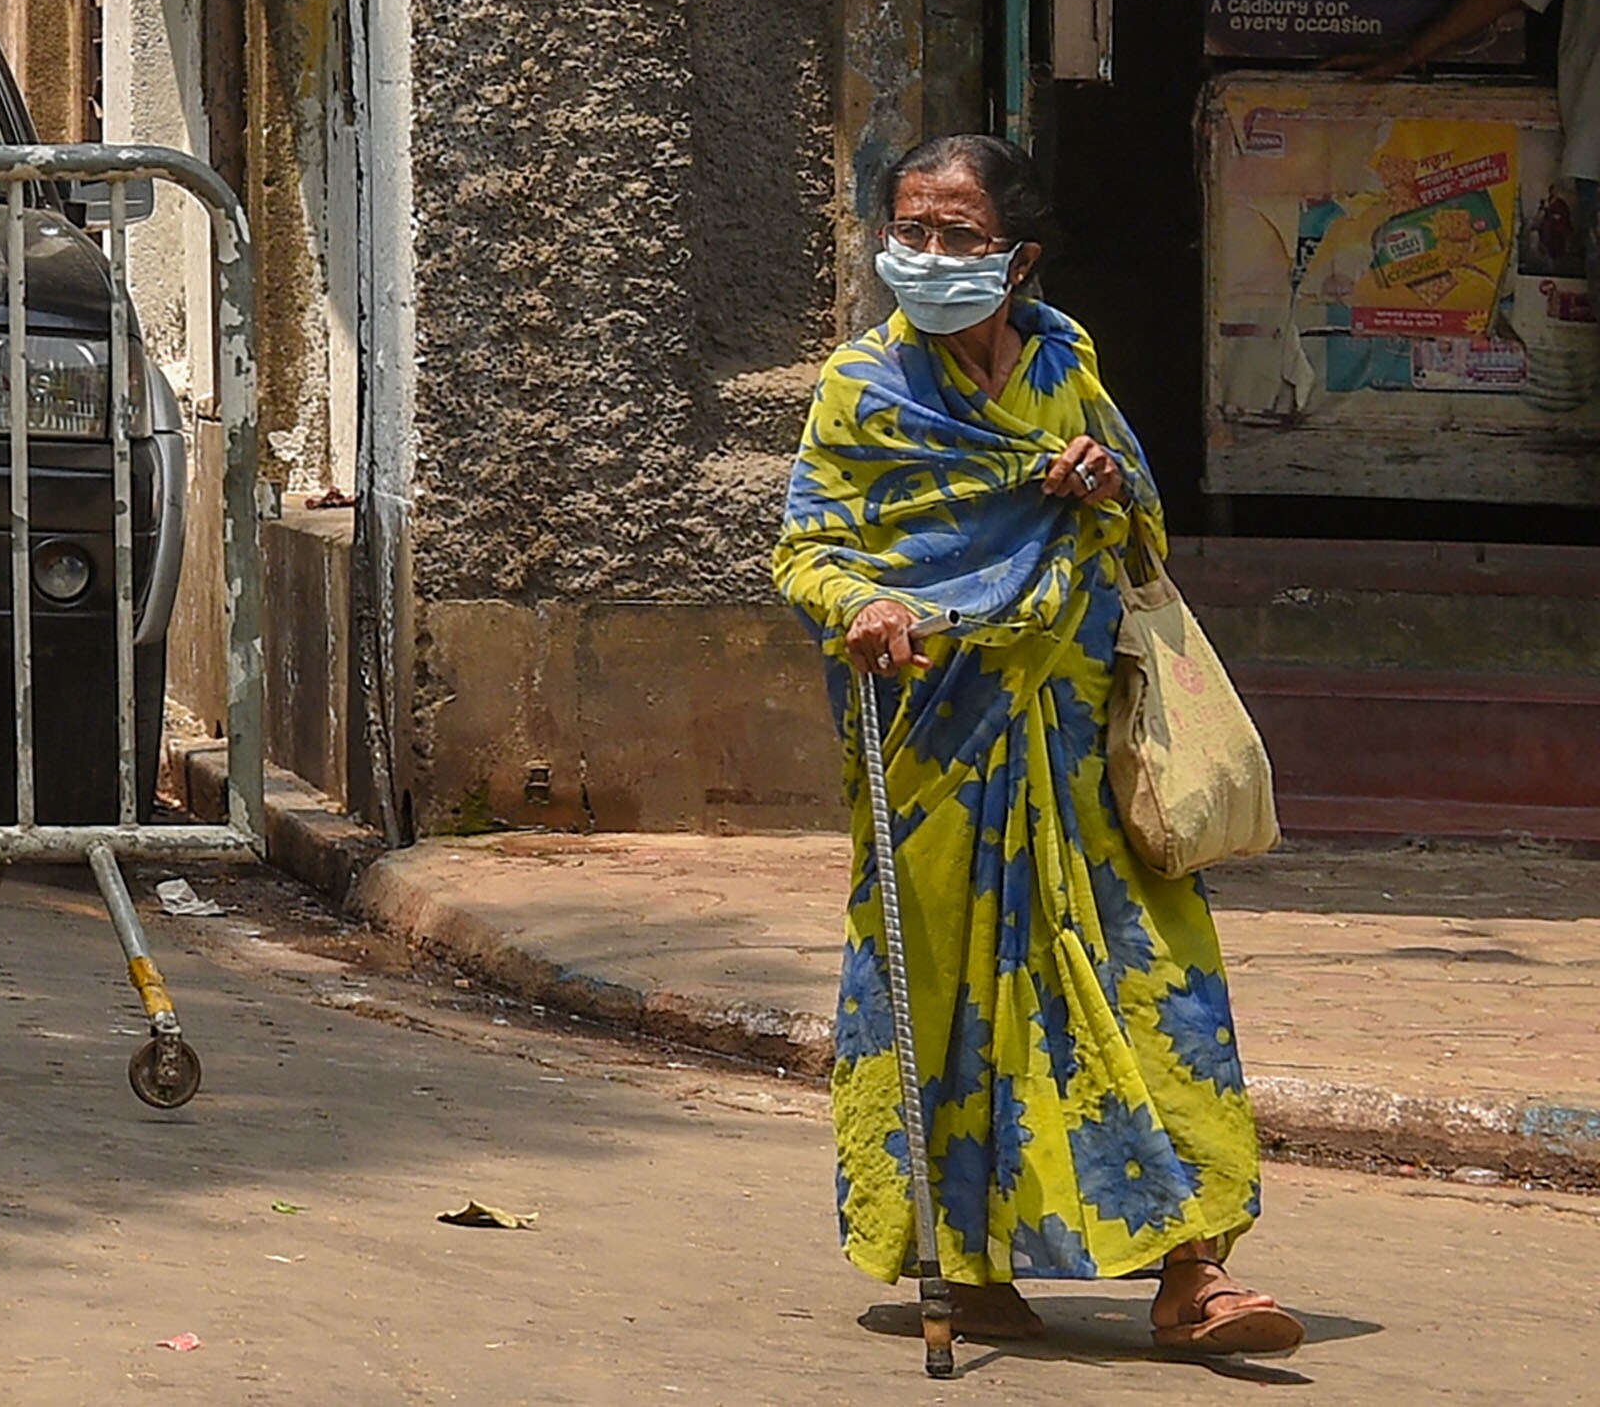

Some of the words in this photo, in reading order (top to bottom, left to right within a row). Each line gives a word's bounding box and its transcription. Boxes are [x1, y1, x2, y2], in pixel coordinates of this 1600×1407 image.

[1313, 0, 1350, 17] for
[1229, 14, 1288, 32] every
[1294, 14, 1383, 35] occasion
